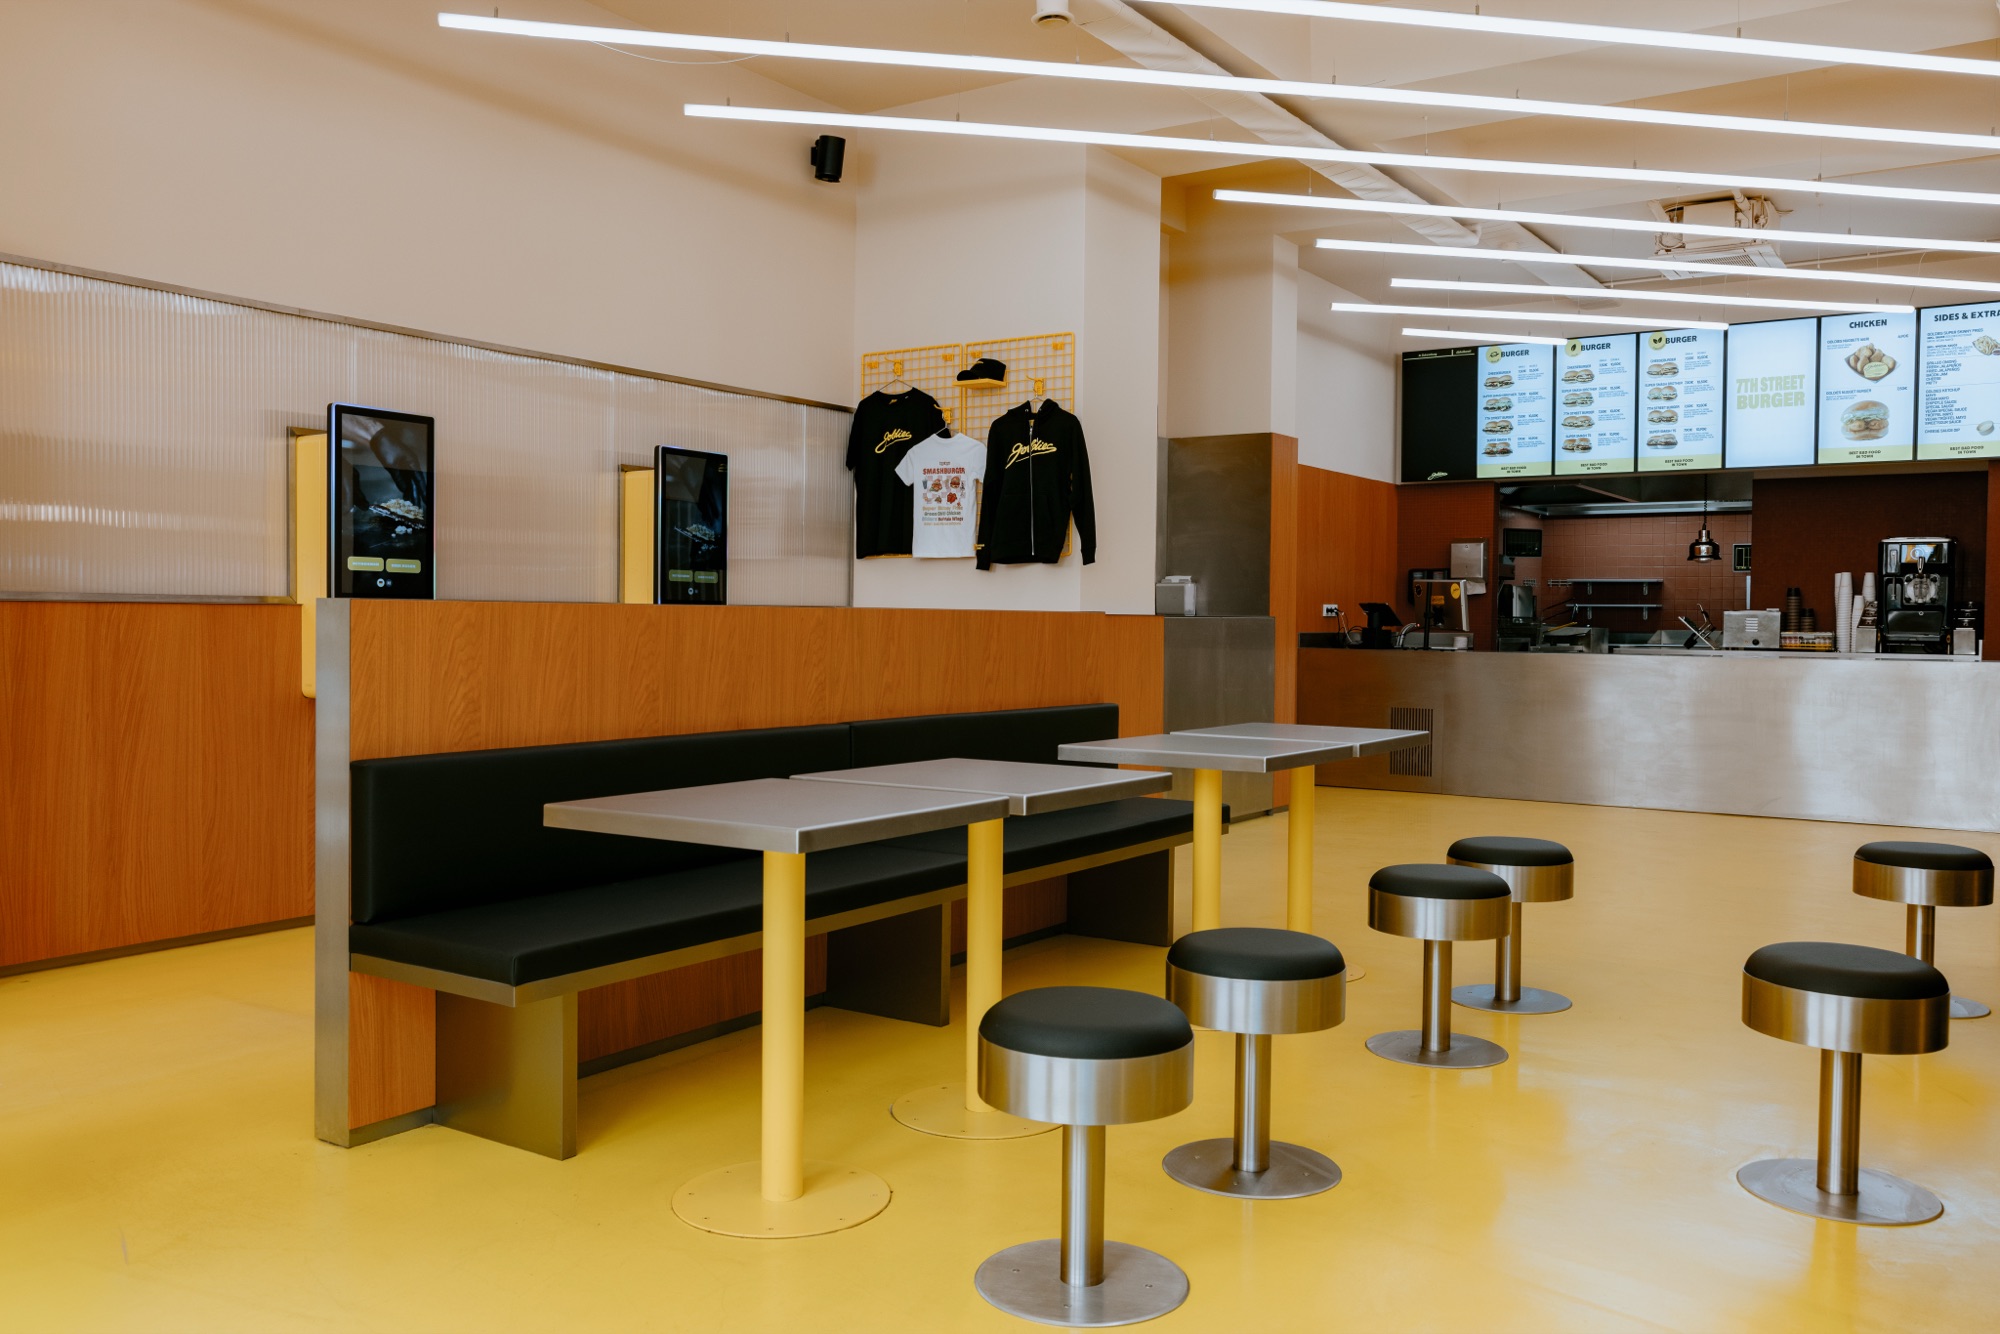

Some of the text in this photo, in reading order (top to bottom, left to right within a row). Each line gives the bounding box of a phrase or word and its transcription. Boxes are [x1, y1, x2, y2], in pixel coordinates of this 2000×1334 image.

[1934, 312, 1959, 322] SIDES
[1961, 312, 1968, 320] &
[1849, 318, 1887, 329] CHICKEN
[1665, 335, 1697, 344] BURGER
[1581, 343, 1611, 351] BURGER
[1501, 349, 1529, 358] BURGER
[1736, 374, 1805, 394] 7TH STREET
[1736, 391, 1805, 410] BURGER
[922, 467, 965, 475] SMASHBURGER
